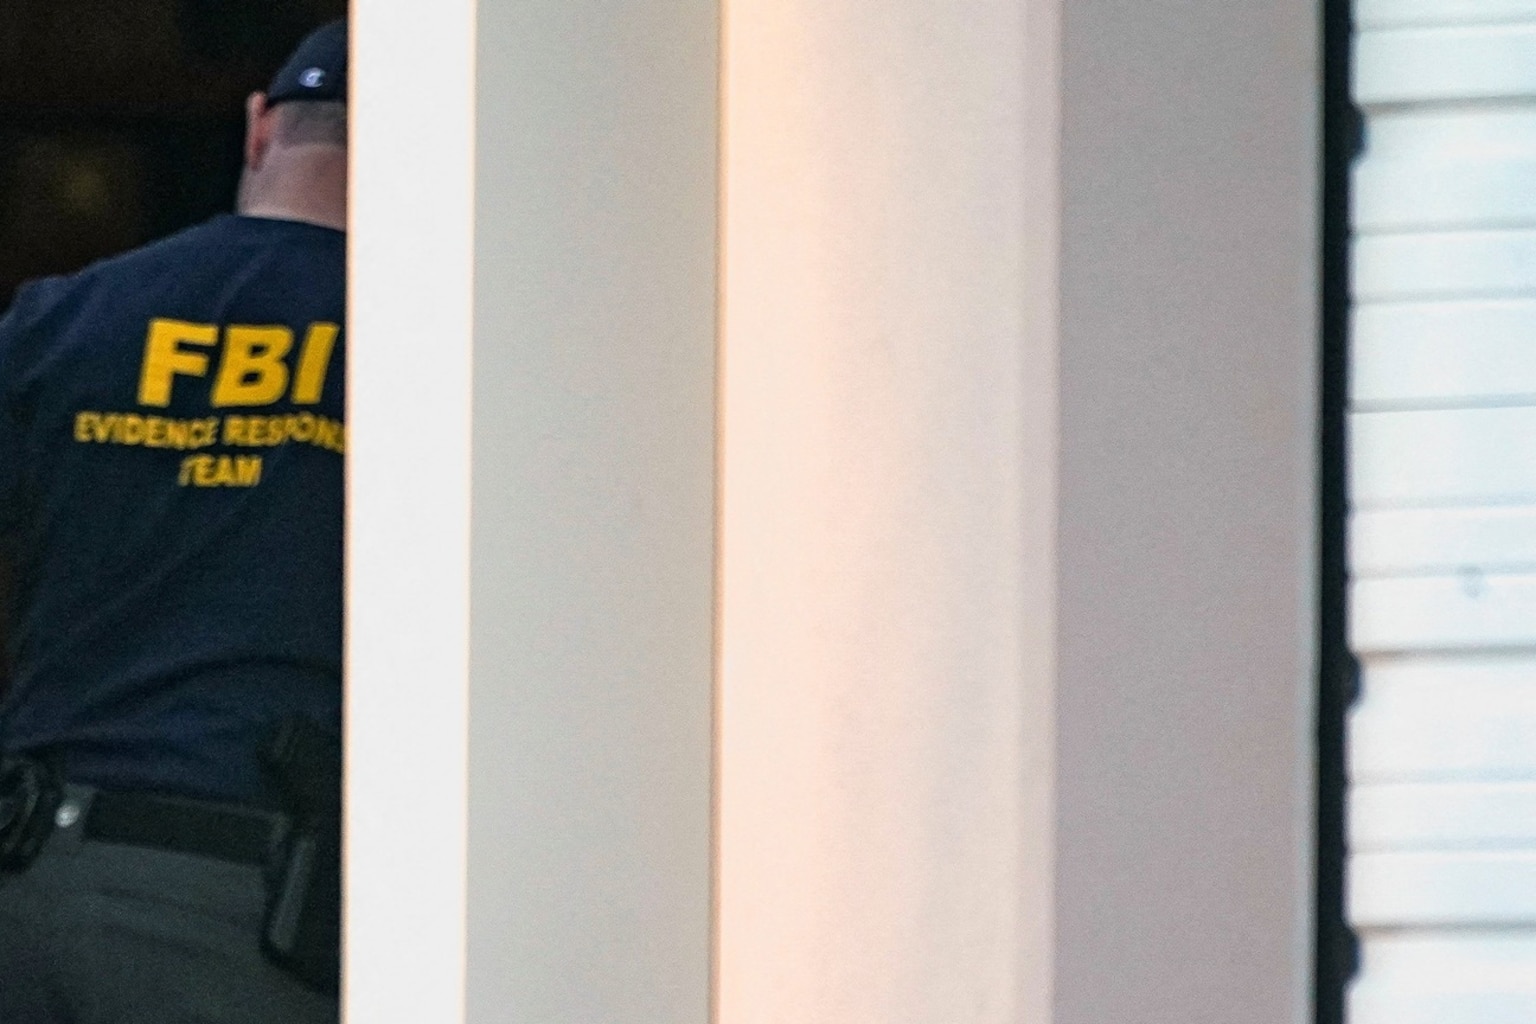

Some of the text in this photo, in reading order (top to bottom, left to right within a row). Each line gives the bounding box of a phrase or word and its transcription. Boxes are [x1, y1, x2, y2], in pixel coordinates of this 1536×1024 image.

[137, 317, 341, 408] FBI
[73, 410, 346, 455] EVIDENCE RESPON
[177, 453, 263, 487] TEAM
